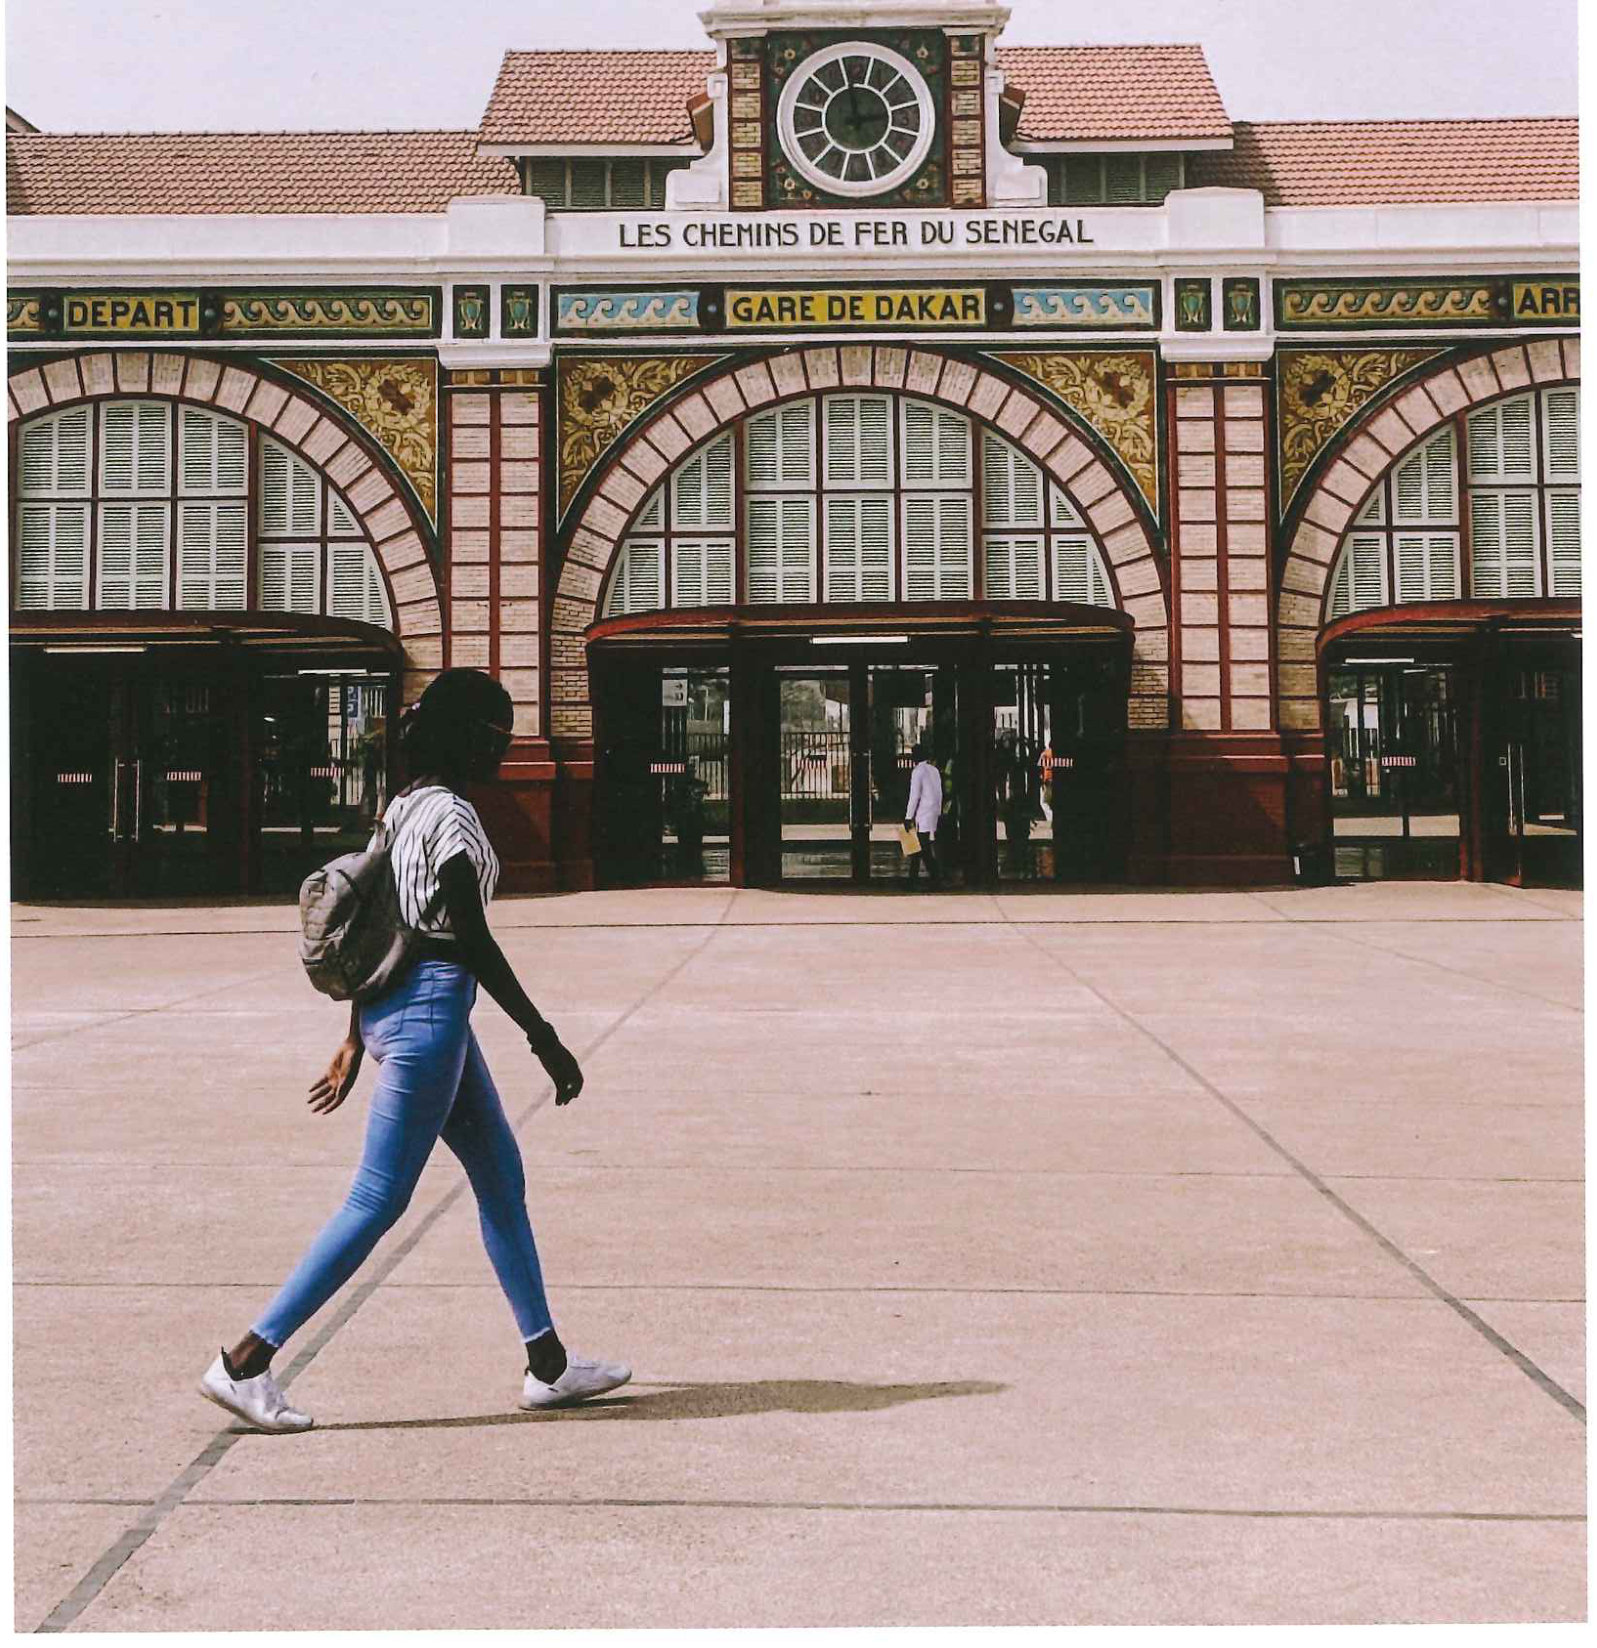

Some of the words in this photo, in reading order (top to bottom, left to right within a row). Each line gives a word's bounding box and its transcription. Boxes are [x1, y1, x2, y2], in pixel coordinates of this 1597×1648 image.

[619, 224, 672, 248] LES
[682, 223, 799, 247] CHEMINS
[809, 222, 844, 246] DE
[855, 221, 908, 246] FER
[921, 221, 954, 245] DU
[966, 219, 1095, 244] SENEGAL
[68, 300, 197, 327] DEPART
[732, 296, 815, 322] GARE
[827, 295, 865, 321] DE
[875, 294, 980, 320] DAKAR
[1517, 287, 1580, 315] ARR
